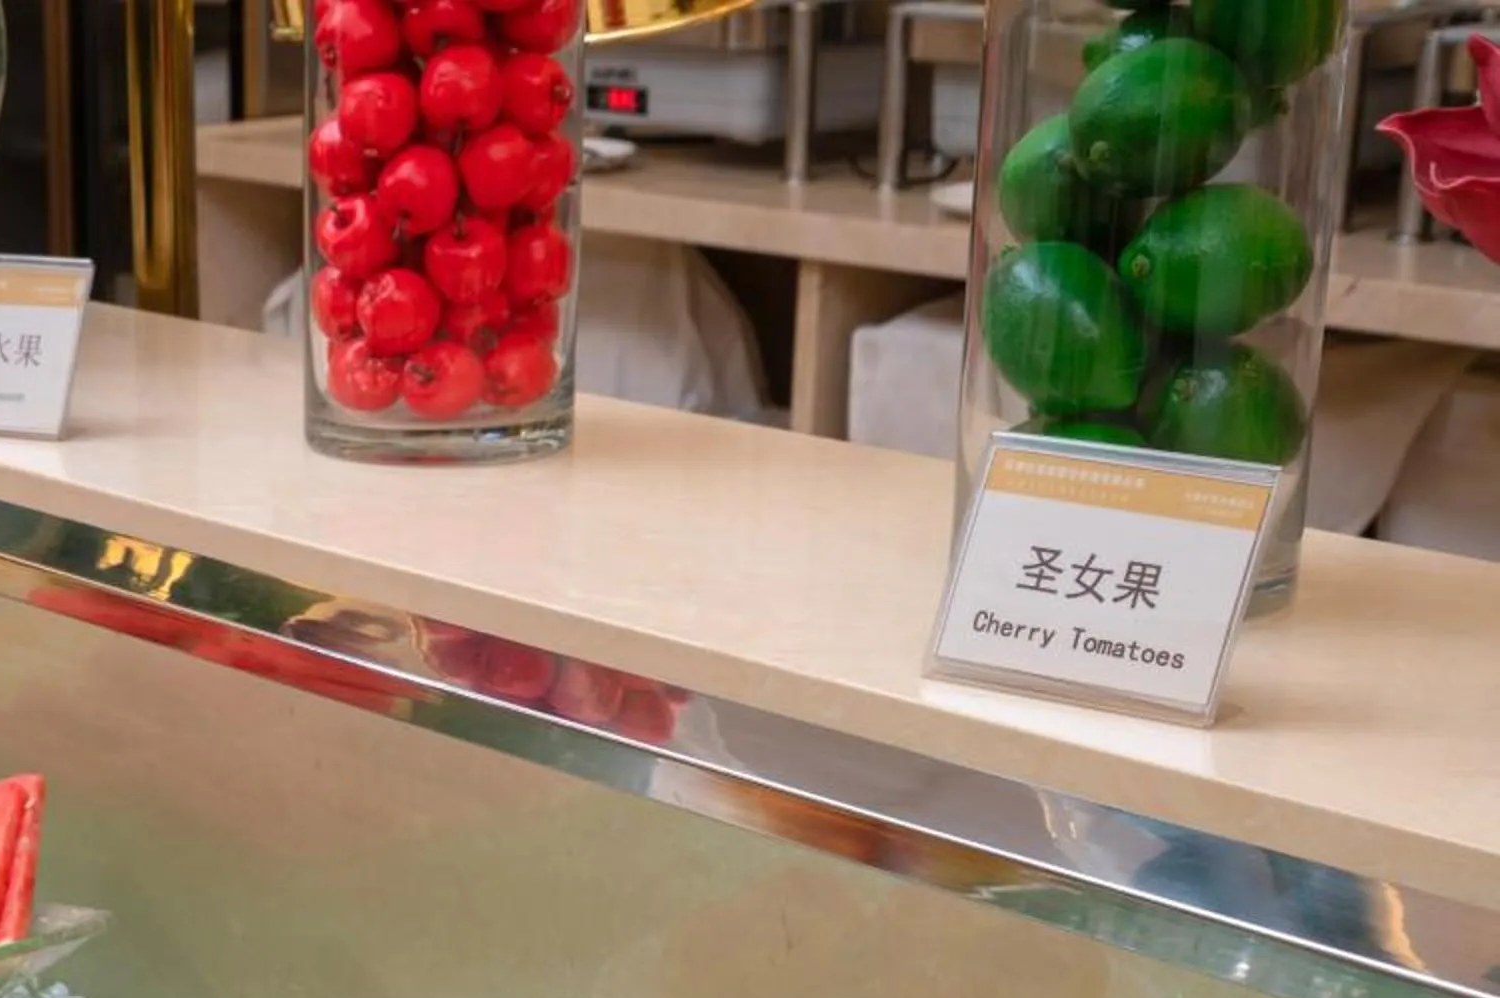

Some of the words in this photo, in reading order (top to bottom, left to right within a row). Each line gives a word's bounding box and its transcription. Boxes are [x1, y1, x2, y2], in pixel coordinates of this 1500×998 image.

[1016, 545, 1163, 610] 圣女果
[972, 609, 1056, 649] Cherry
[1071, 626, 1186, 670] Tomatoes
